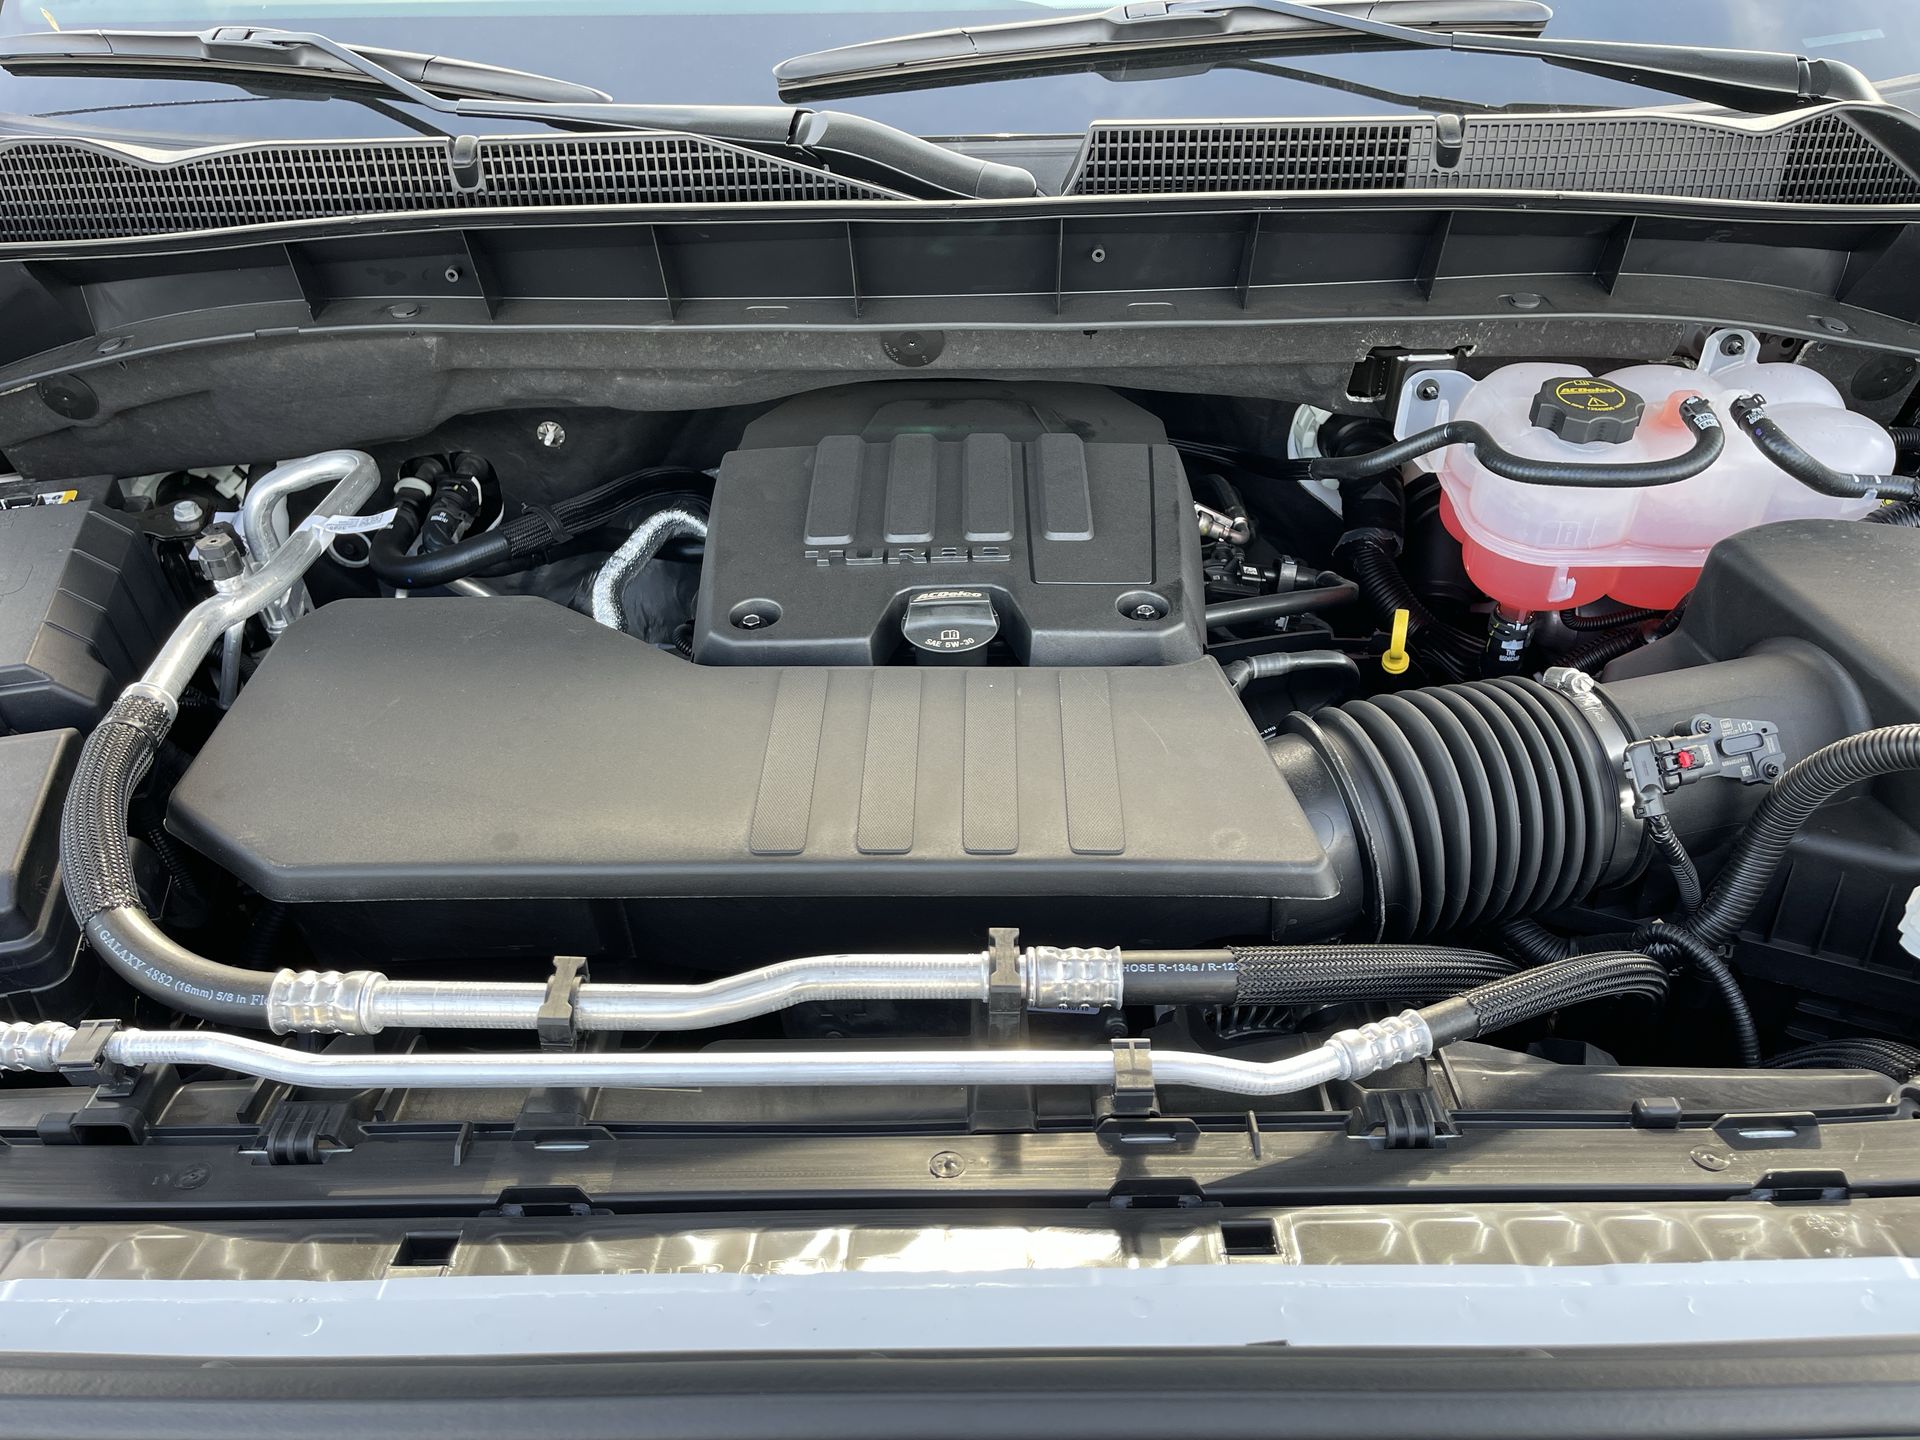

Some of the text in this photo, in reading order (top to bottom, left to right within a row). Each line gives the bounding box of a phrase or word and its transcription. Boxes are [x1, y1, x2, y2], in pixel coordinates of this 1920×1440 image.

[805, 546, 1011, 567] TURBO
[913, 591, 982, 602] ACDelco
[925, 637, 975, 648] SAE 5W-30
[99, 930, 146, 971] GALAXY
[145, 966, 173, 987] 4882
[174, 980, 214, 1000] (16mm)
[215, 991, 234, 1002] 5/8
[236, 994, 246, 1004] in
[1122, 963, 1155, 973] HOSE
[1158, 963, 1199, 972] R-134a
[1200, 963, 1205, 972] /
